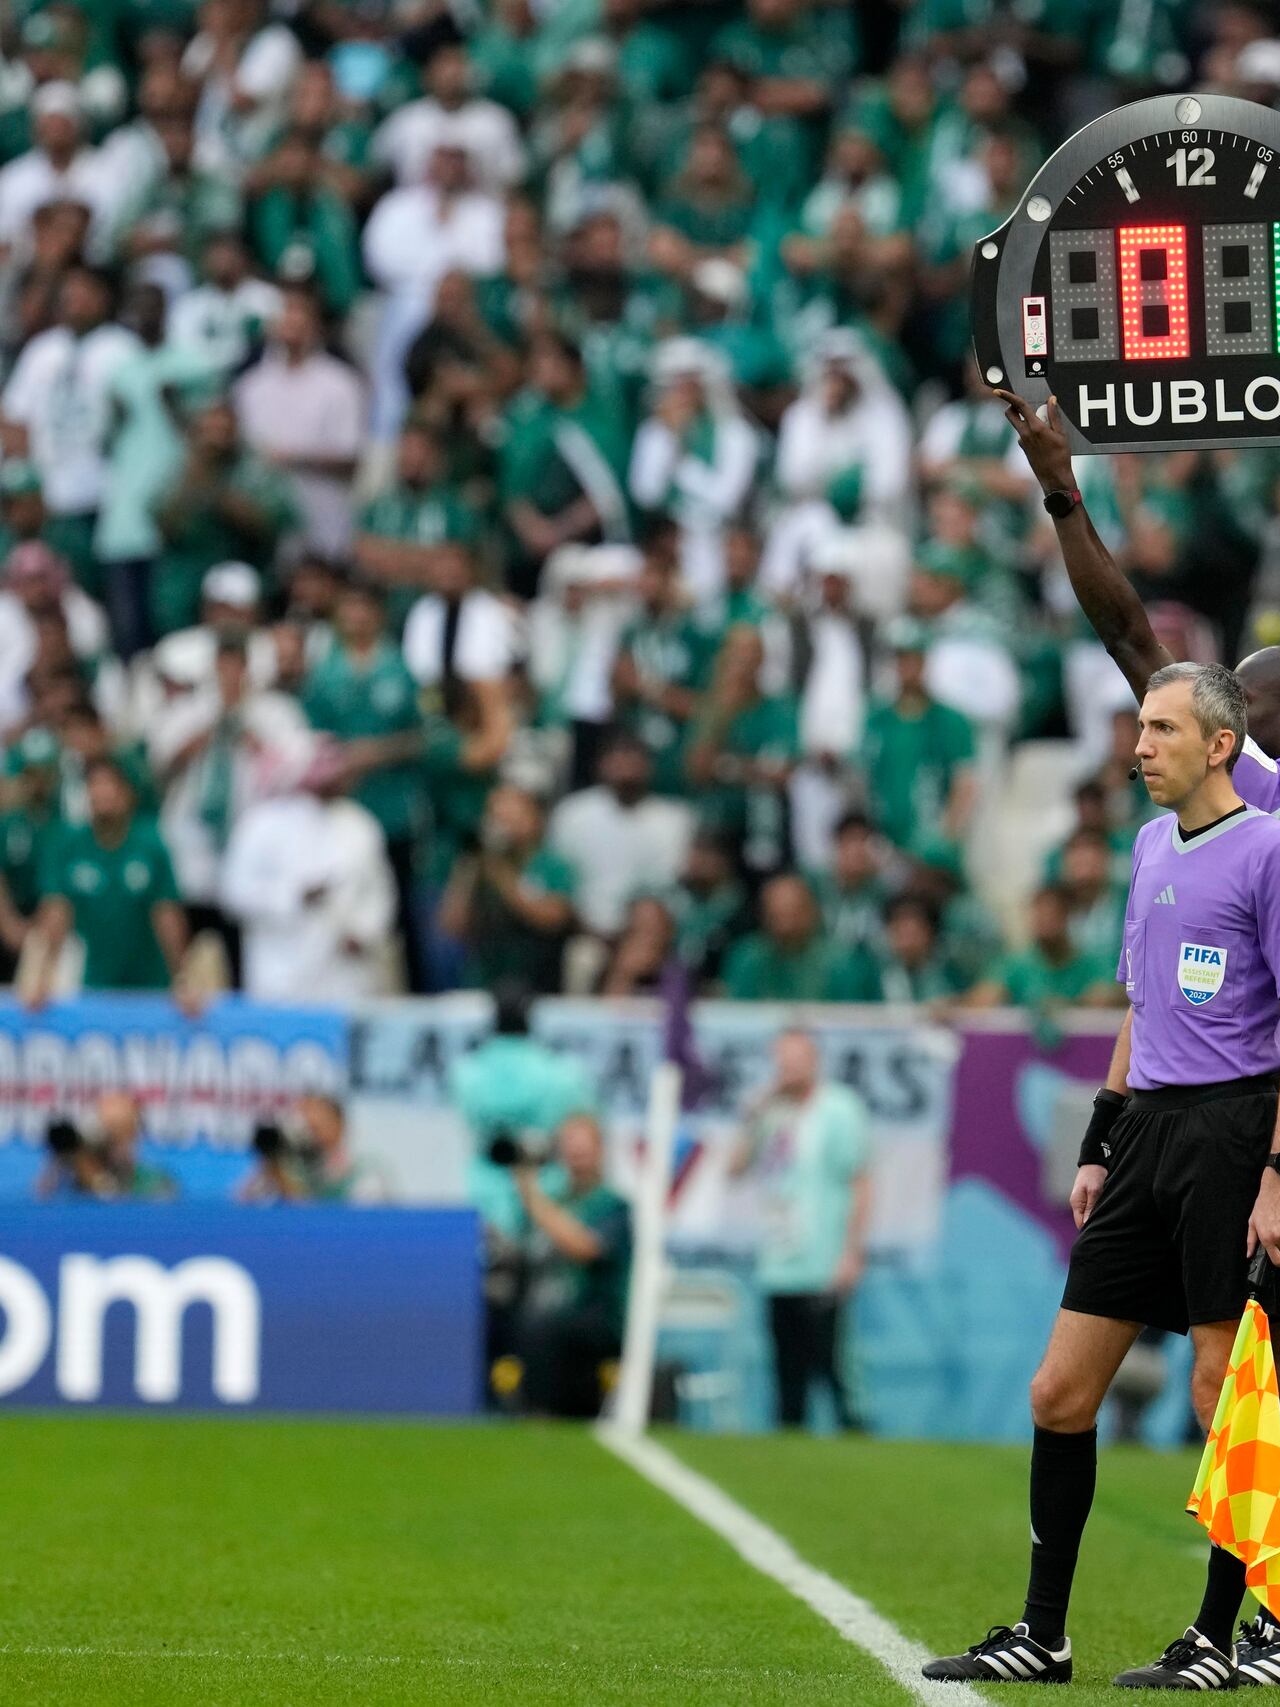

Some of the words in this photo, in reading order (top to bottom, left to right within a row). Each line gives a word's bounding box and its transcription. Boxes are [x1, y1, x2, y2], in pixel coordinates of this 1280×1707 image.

[1181, 131, 1198, 143] 60
[1107, 151, 1125, 169] 55
[1257, 146, 1274, 162] 05
[1165, 147, 1217, 187] 12
[1183, 946, 1221, 966] FIFA
[1183, 967, 1220, 978] ASSISTANT
[1184, 975, 1216, 985] REFEREE
[1188, 990, 1207, 1000] 2022
